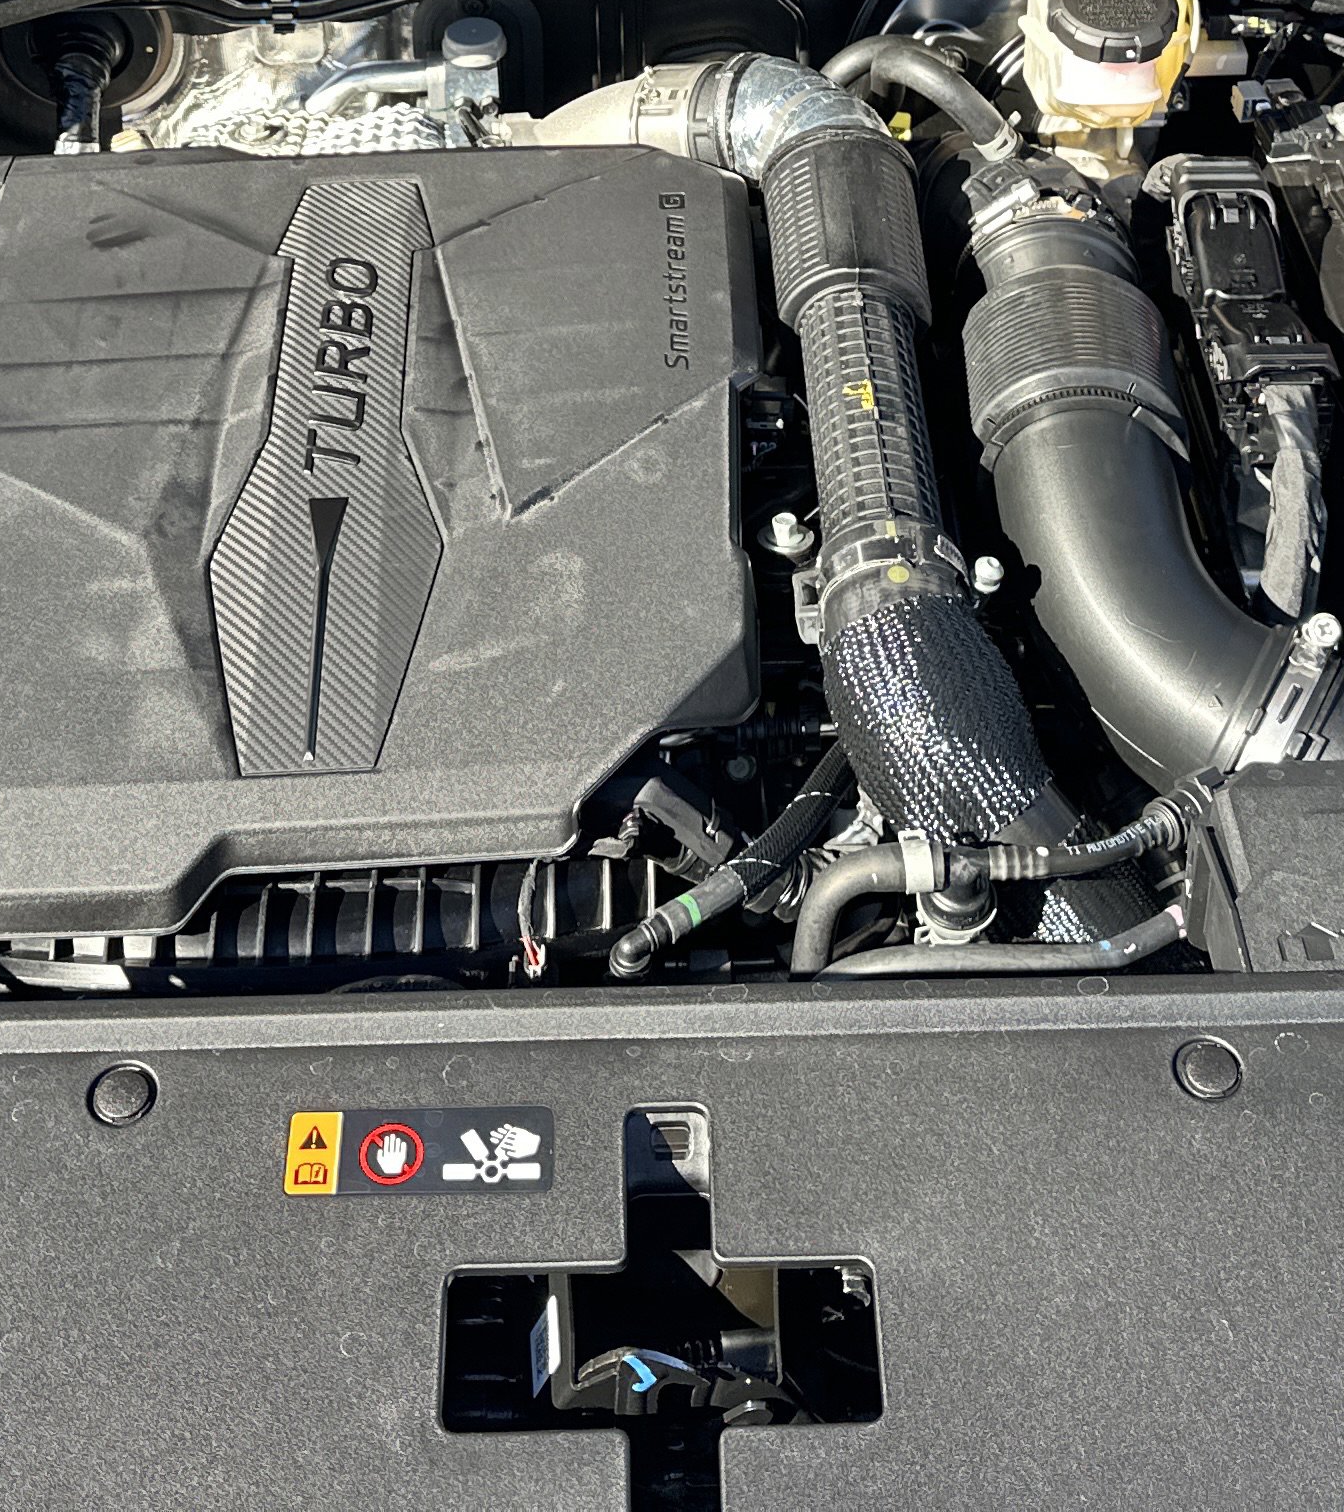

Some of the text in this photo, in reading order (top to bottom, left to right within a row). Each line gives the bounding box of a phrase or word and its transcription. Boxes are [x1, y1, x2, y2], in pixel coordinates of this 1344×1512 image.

[304, 257, 378, 474] TURBO
[659, 192, 689, 370] Smartstream G
